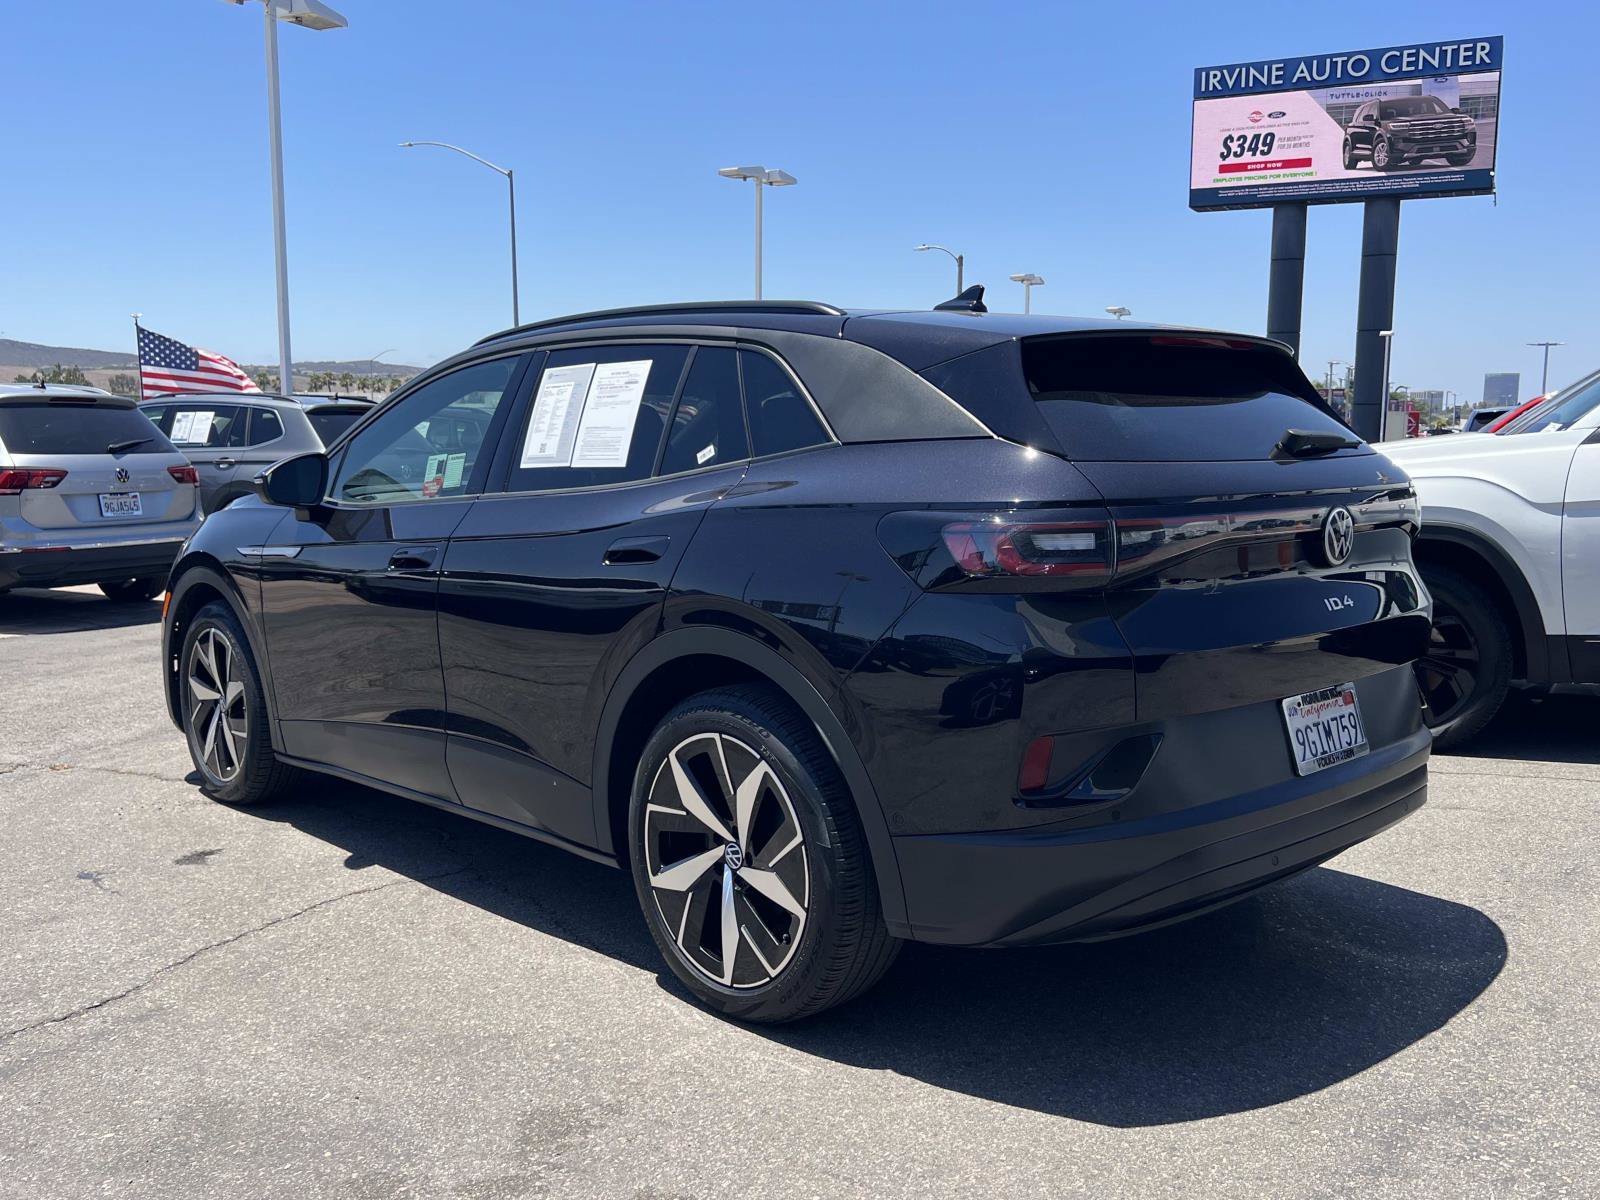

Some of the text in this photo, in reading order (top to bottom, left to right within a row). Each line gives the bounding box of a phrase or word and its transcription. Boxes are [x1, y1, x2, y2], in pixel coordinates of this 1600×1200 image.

[1200, 42, 1492, 92] IRVINE AUTO CENTER
[1329, 90, 1388, 99] TUTTLE-CLICK
[1219, 132, 1276, 161] $349
[1247, 162, 1265, 170] SHOP
[1300, 699, 1344, 719] California
[1295, 712, 1358, 762] 9GIM759
